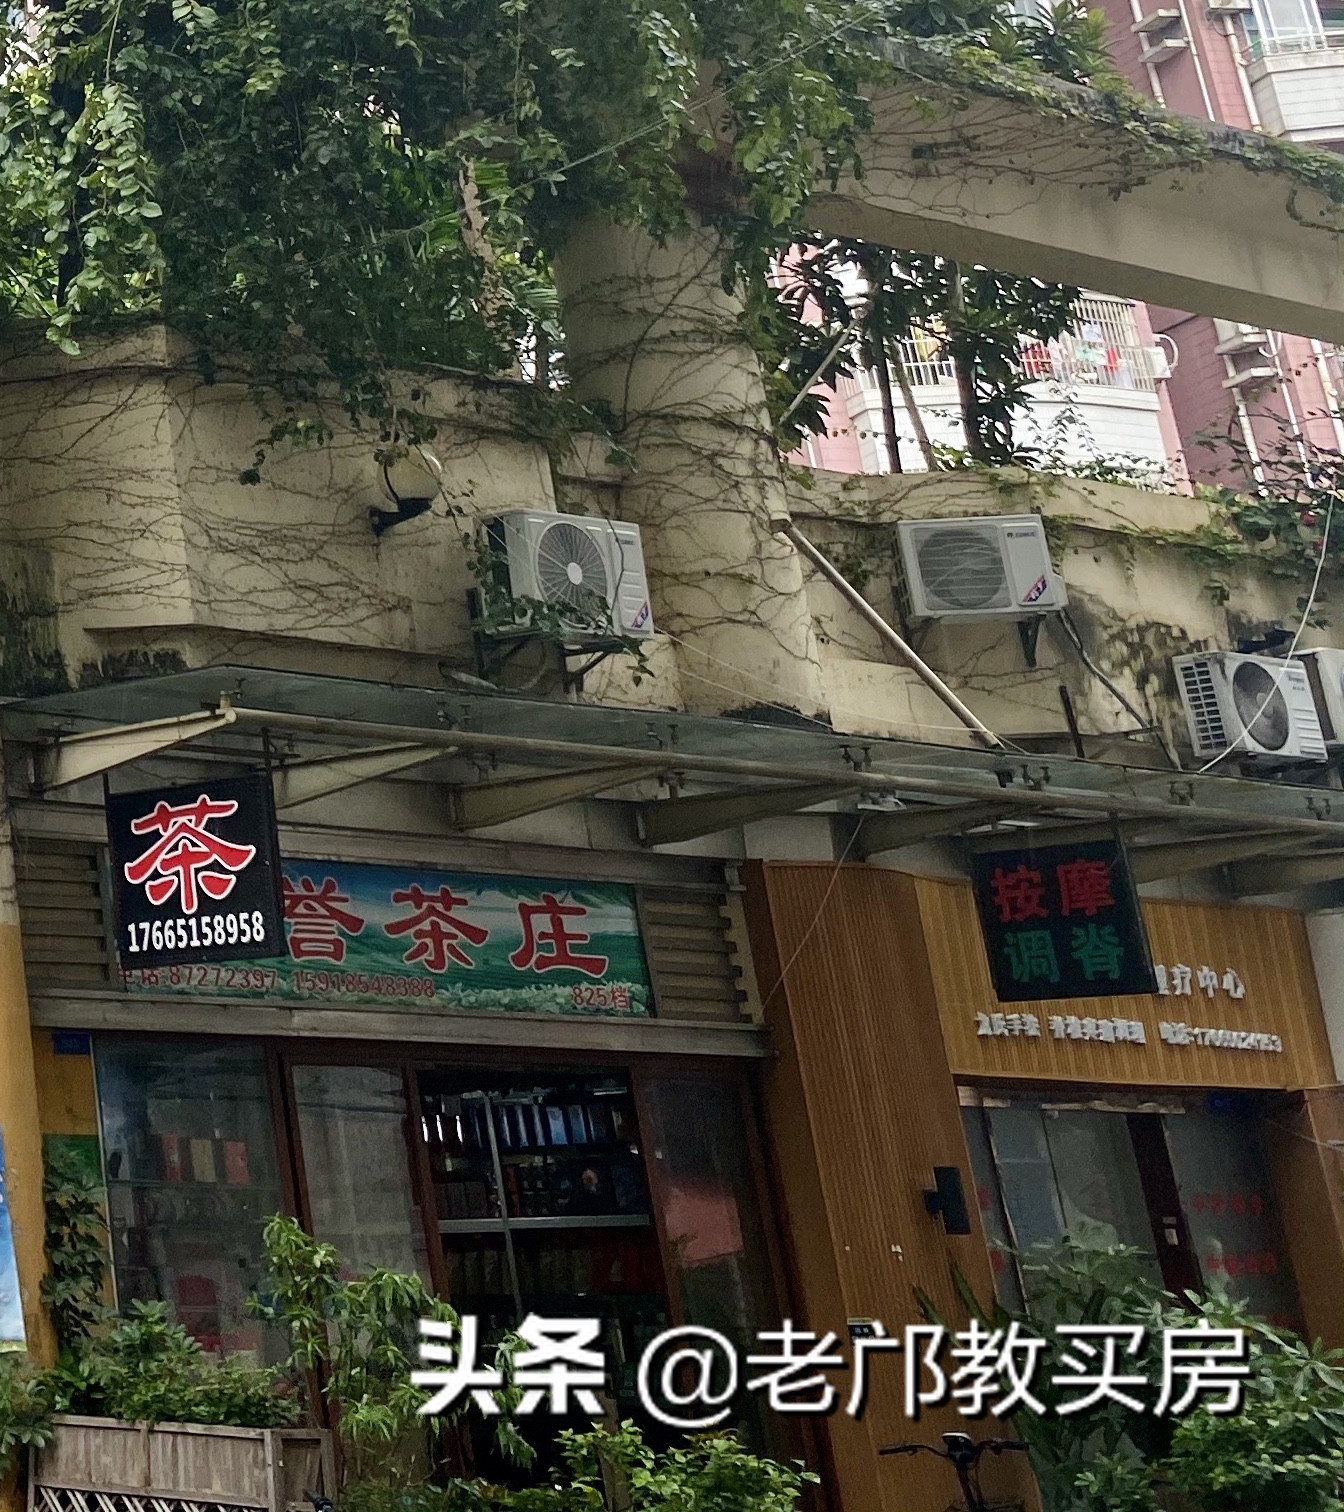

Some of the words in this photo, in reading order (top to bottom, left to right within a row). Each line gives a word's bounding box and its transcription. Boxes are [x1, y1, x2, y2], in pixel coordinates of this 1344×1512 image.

[125, 794, 256, 914] 茶
[992, 859, 1115, 922] 按摩
[128, 911, 265, 952] 17665158958
[1004, 922, 1126, 984] 调脊
